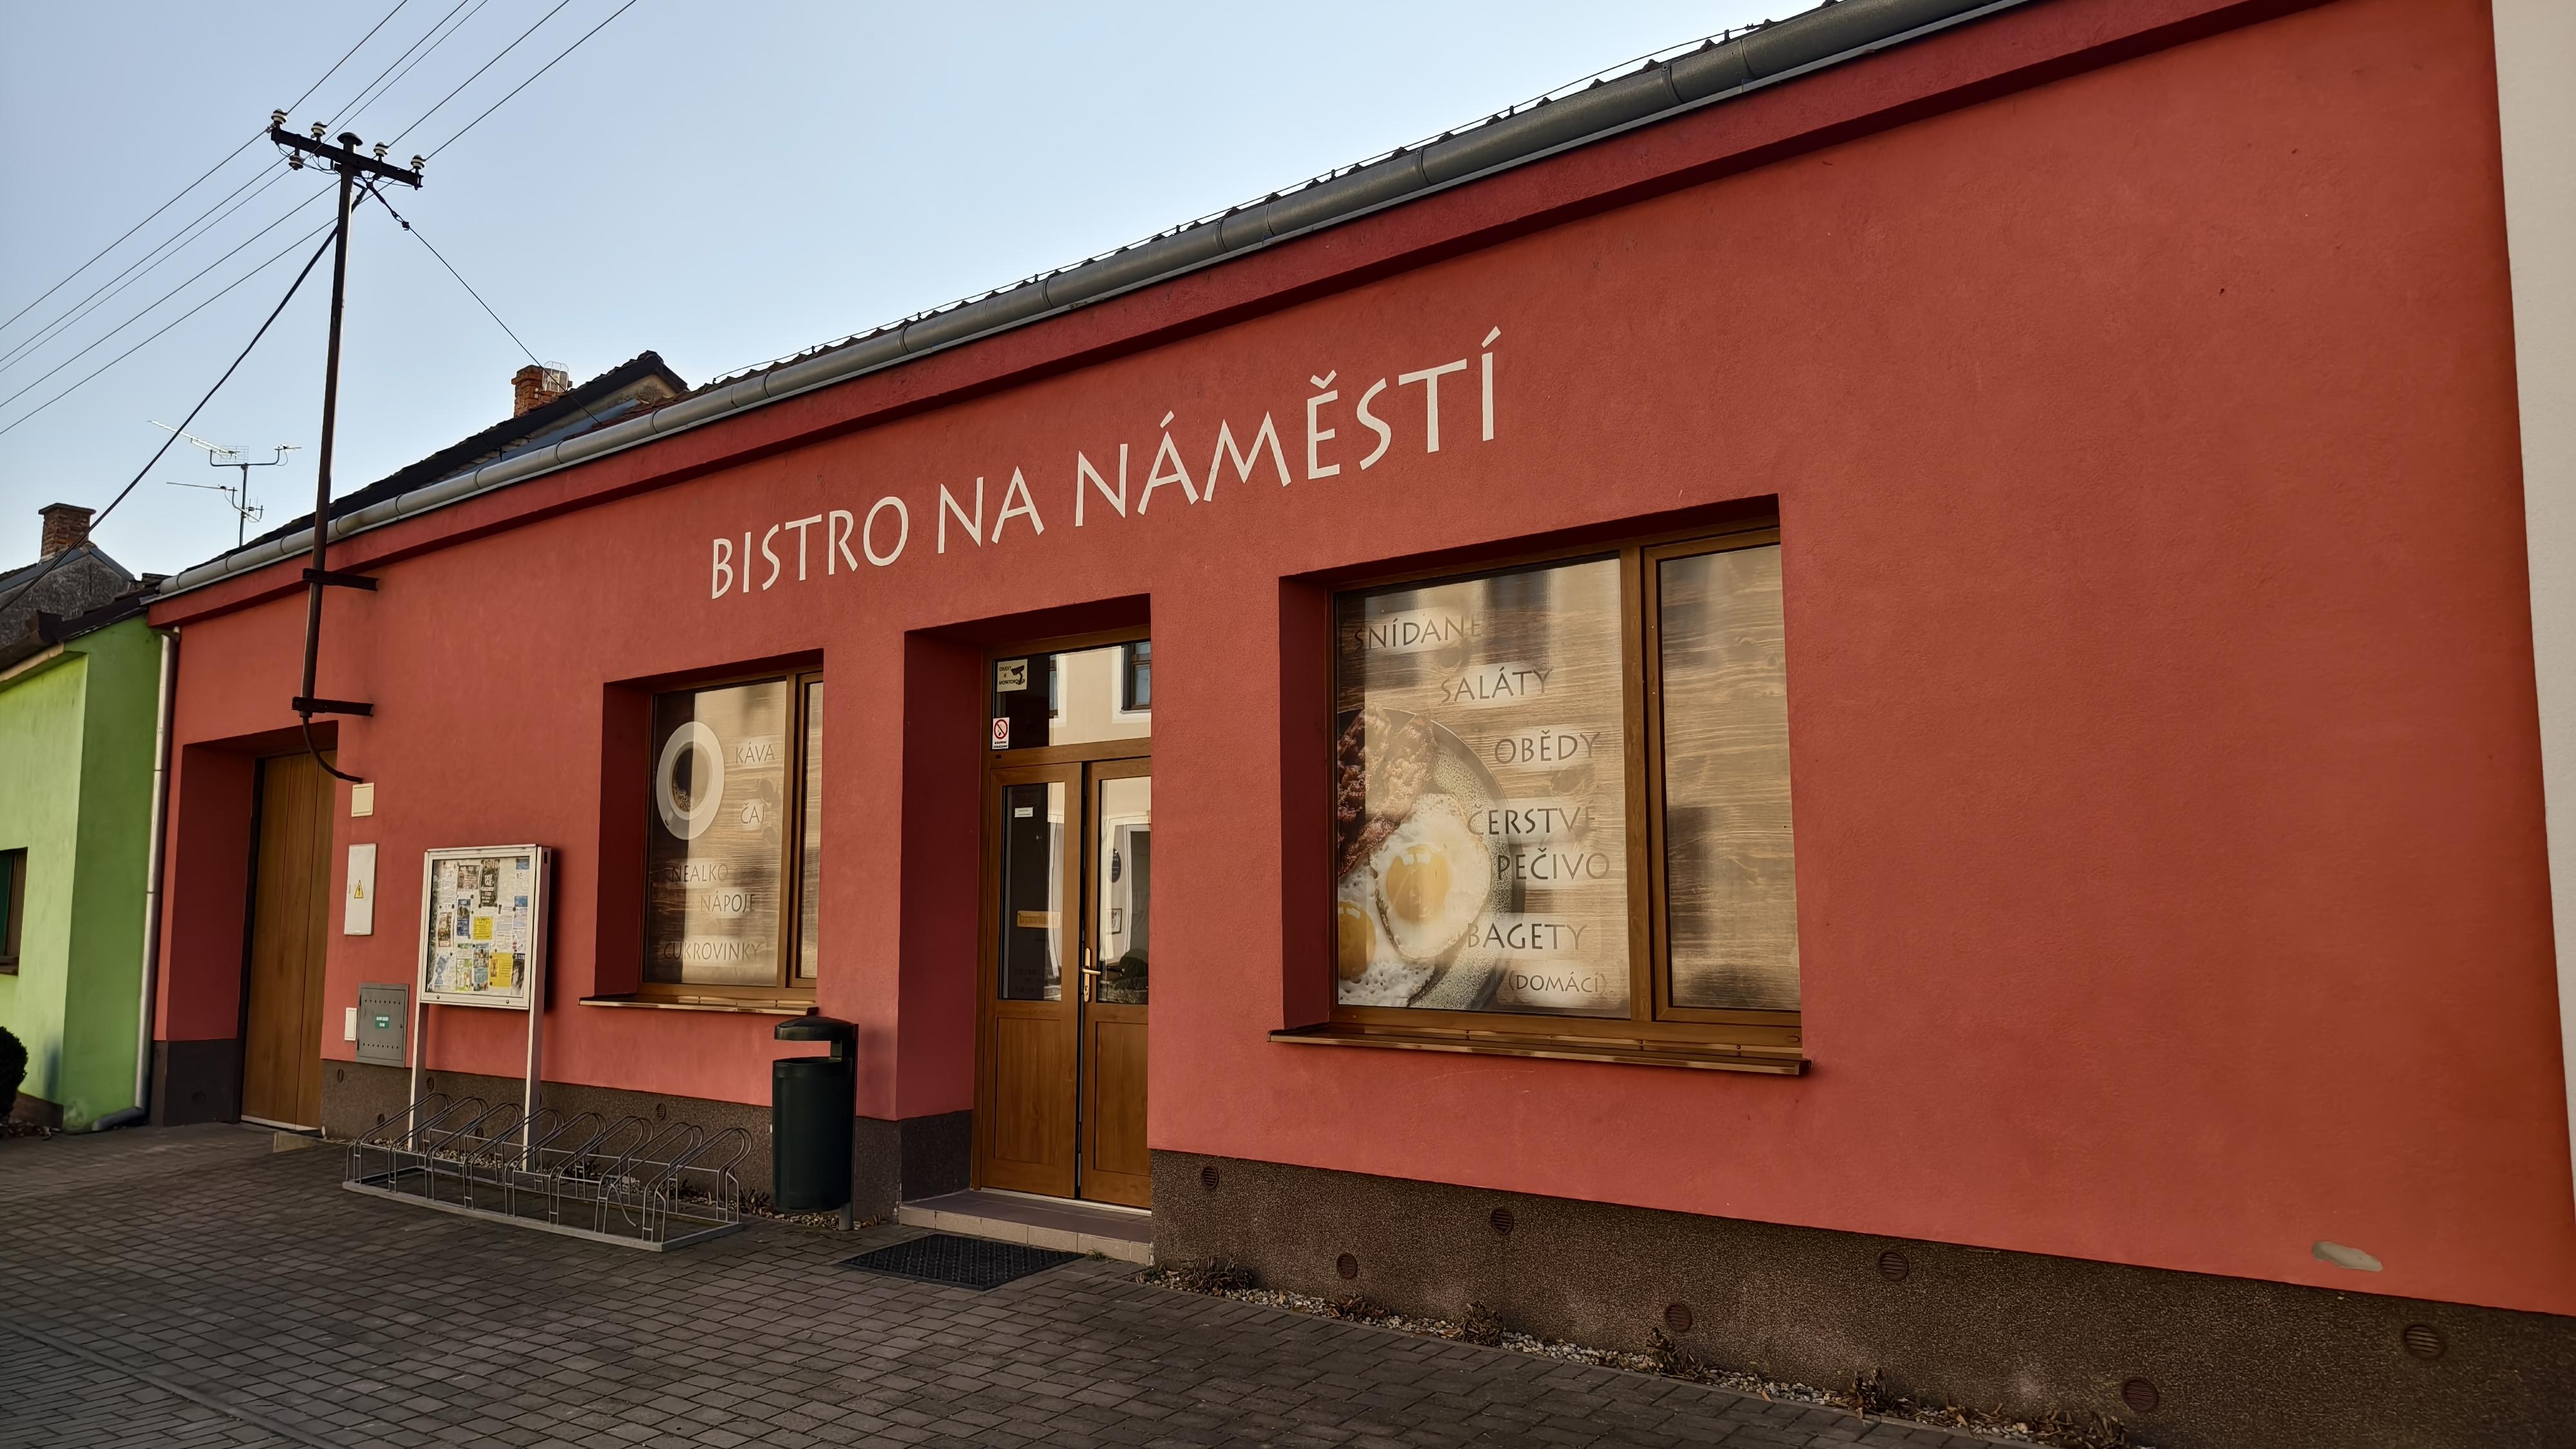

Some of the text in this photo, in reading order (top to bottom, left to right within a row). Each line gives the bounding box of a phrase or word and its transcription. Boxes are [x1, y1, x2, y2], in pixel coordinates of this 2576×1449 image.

[711, 325, 1501, 600] BISTRO NA NÁMĚSTÍ
[1440, 666, 1553, 703] SALÁTY
[735, 741, 775, 764] KÁVA
[1494, 729, 1601, 764] OBĚDY
[740, 802, 765, 824] ČAJ
[1467, 800, 1598, 836] ČERSTVÉ
[671, 864, 728, 882] NEALKO
[1497, 847, 1610, 880] PEČIVO
[1468, 922, 1587, 950] BAGETY
[664, 942, 764, 961] CUKROVINKY
[1508, 971, 1607, 993] (DOMÁCÍ)
